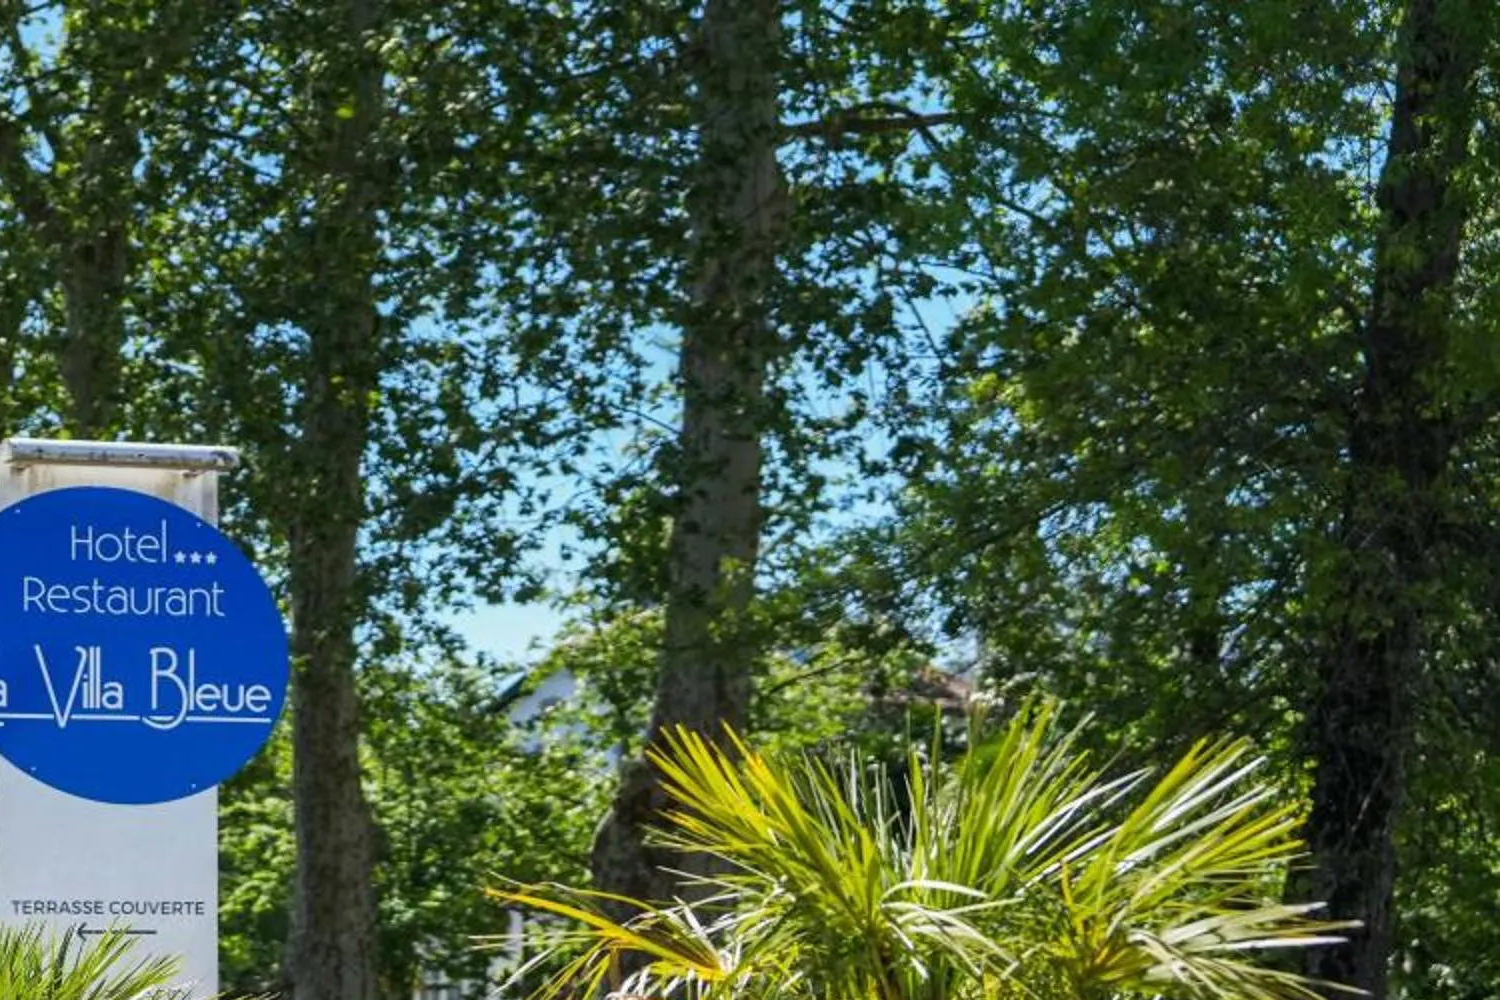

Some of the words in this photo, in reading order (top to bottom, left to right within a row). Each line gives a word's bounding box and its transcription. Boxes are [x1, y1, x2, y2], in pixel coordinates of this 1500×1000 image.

[70, 519, 168, 563] Hotel
[23, 576, 226, 618] Restaurant
[33, 643, 124, 728] Villa
[141, 646, 272, 730] Bleue
[11, 900, 105, 916] TERRASSE
[108, 900, 206, 916] COUVERTE
